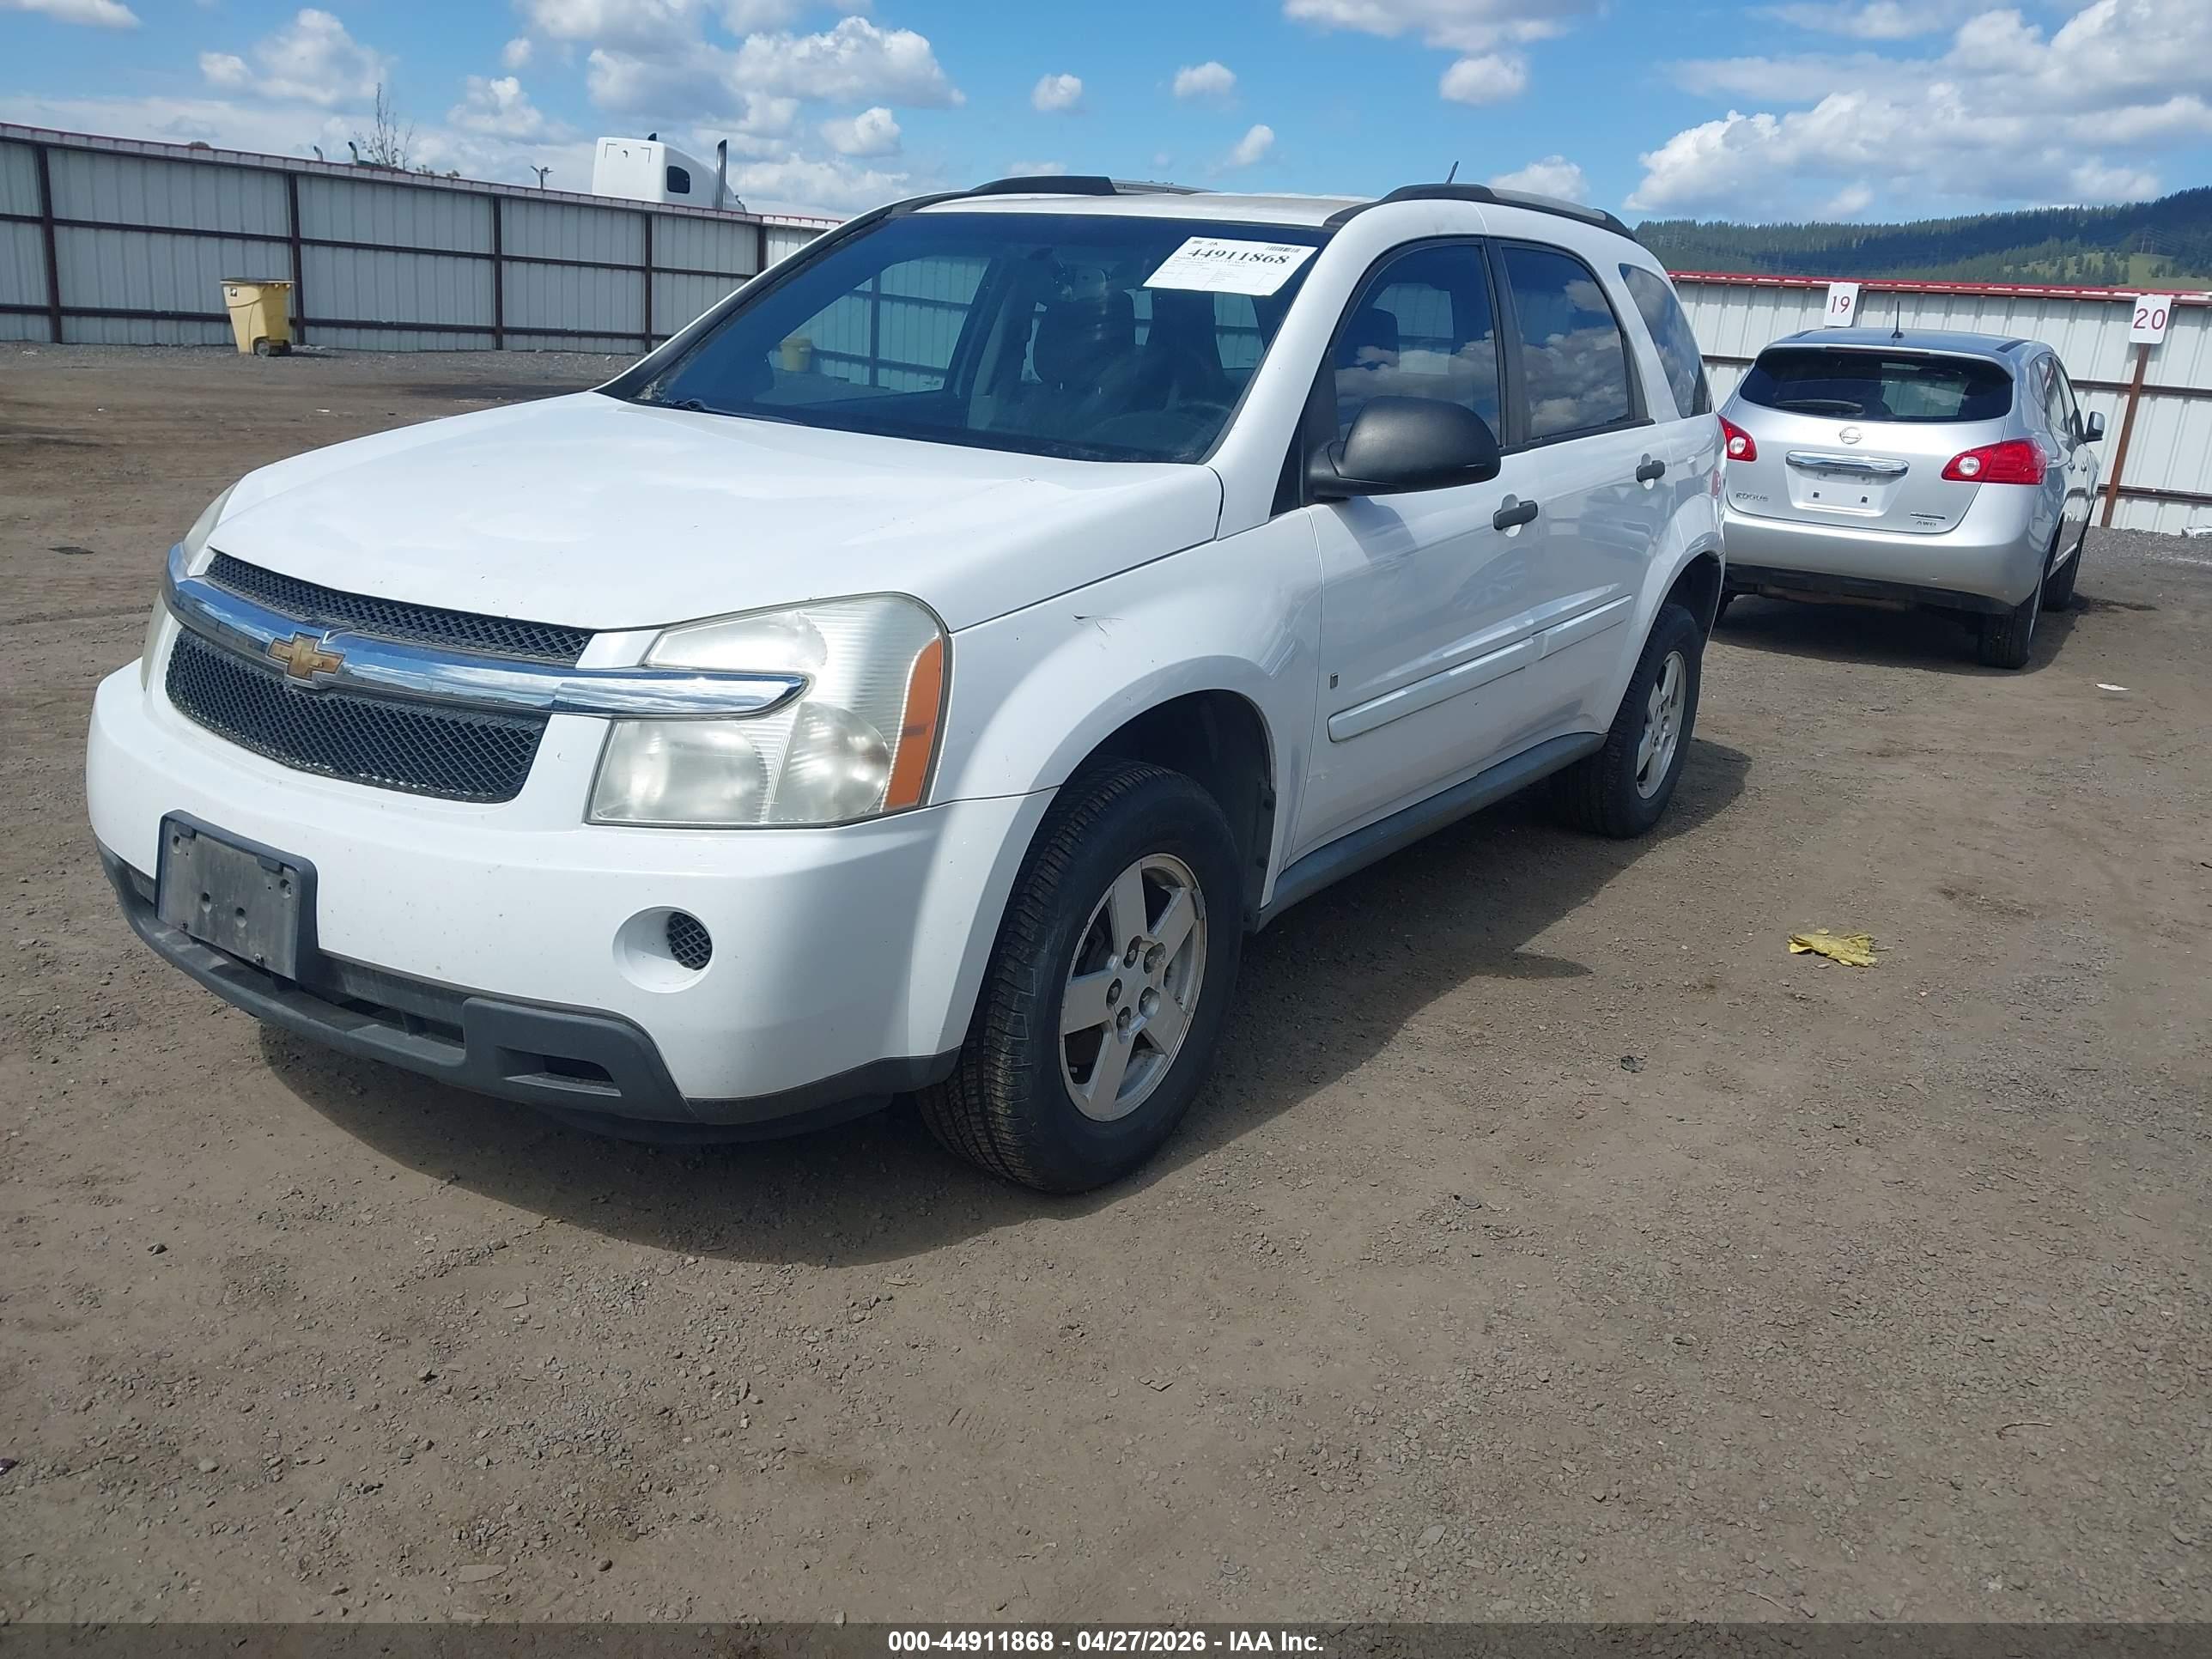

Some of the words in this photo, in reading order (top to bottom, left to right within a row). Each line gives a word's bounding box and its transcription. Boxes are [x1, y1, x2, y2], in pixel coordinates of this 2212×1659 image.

[1188, 247, 1290, 264] 44911868
[1831, 295, 1850, 313] 19
[2133, 307, 2166, 330] 20
